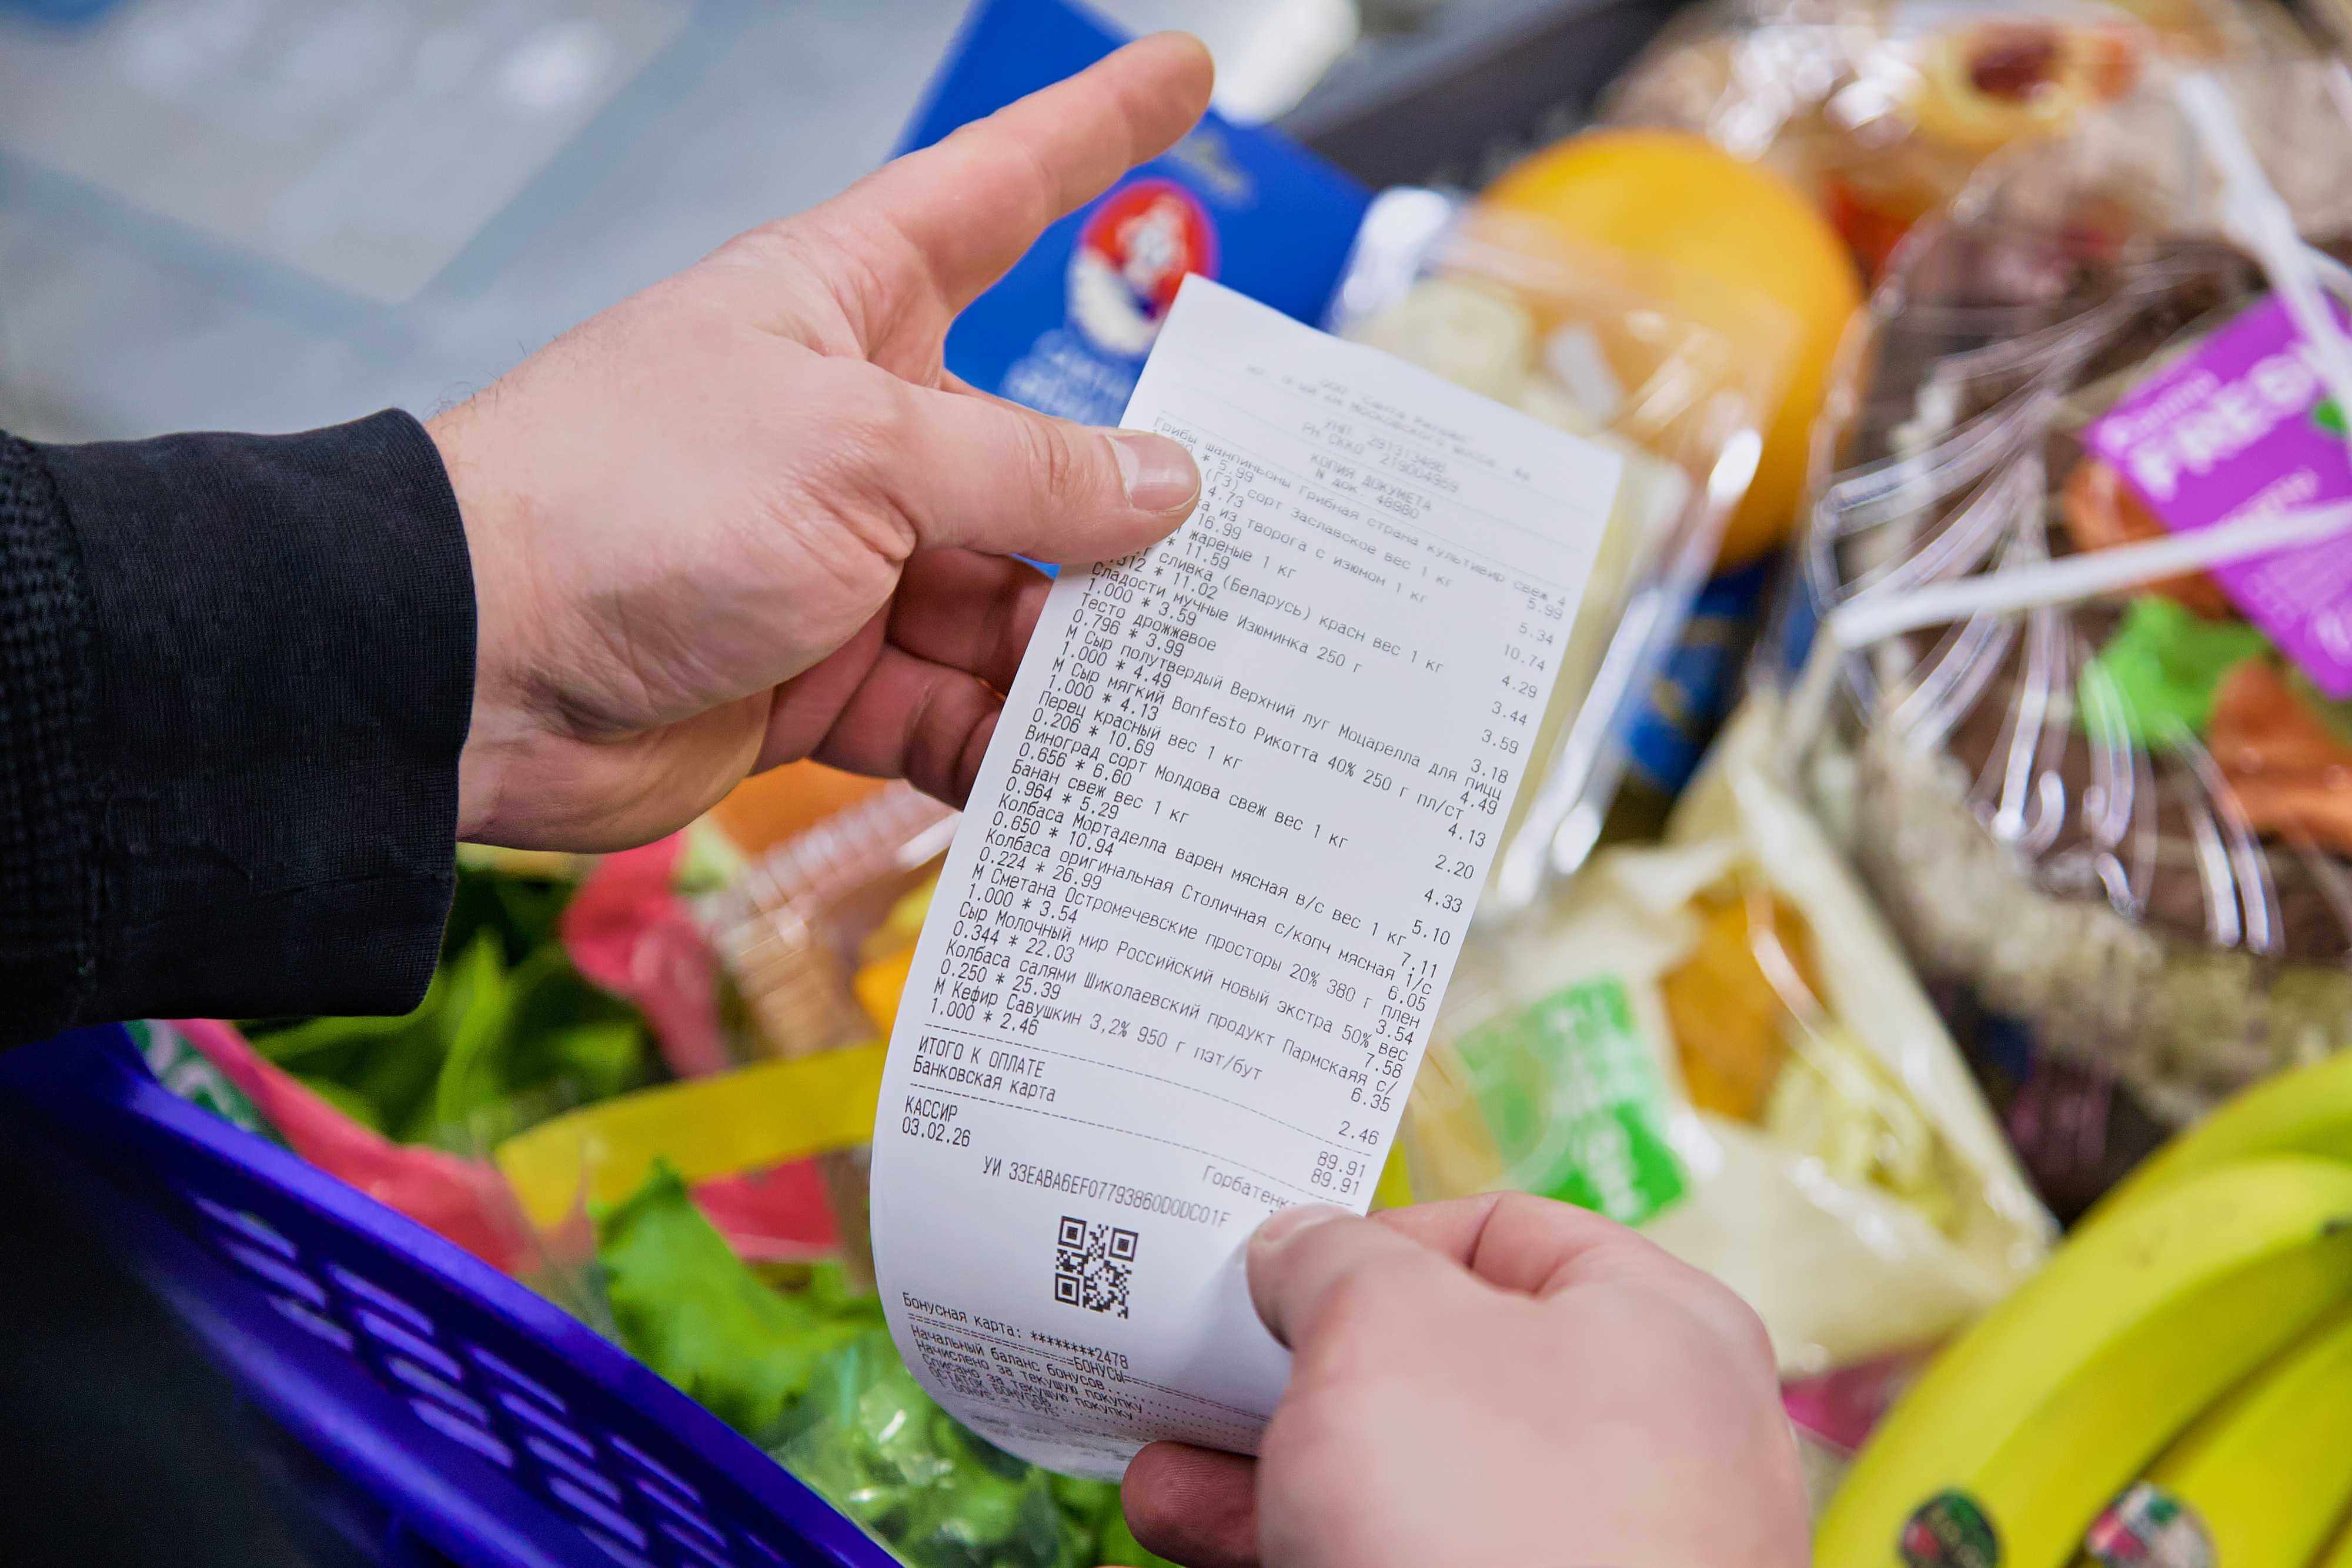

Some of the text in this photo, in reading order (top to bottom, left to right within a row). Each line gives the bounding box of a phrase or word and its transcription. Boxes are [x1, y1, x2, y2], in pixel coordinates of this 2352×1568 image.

[1154, 417, 1197, 444] Грибы
[1204, 442, 1291, 488] шампиньоны
[1298, 484, 1359, 520] Грибная
[1367, 517, 1419, 546] страна
[1514, 581, 1548, 601] свеж
[1218, 459, 1563, 620] 5.99 5.99
[1247, 489, 1282, 510] сорт
[1290, 507, 1377, 554] Заславское
[1310, 453, 1355, 479] КОПИЯ
[1081, 591, 1216, 651] Тесто дрожжевое
[1091, 561, 1345, 667] Сладости мучные Изюминка 250
[1158, 552, 1213, 582] сливка
[1222, 574, 1311, 620] (Беларусь)
[1318, 616, 1365, 641] красн
[1372, 637, 1401, 656] вес
[1185, 541, 1538, 698] 11.59 4.29
[1188, 529, 1252, 561] жареные
[1198, 512, 1545, 671] 16.99 10.74
[1207, 485, 1244, 508] 4.73
[1519, 621, 1553, 645] 5.34
[1247, 518, 1385, 586] творога изюмом
[1038, 690, 1197, 753] Перец красный вес
[1072, 608, 1508, 784] 0.796 3.99 3.18
[1084, 630, 1502, 801] Сыр полутвердый Верхний луг Моцарелла для пицц
[1088, 577, 1519, 754] 1.000 3.59 3.59
[1173, 571, 1527, 726] 11.02 3.44
[1011, 758, 1143, 808] Банан свеж вес
[1024, 723, 1303, 831] Виноград сорт Молдова свеж вес
[1032, 707, 1474, 879] 0.206 10.69 2.20
[1048, 674, 1486, 847] 1.000 4.13 4.13
[1061, 640, 1498, 815] 1.000 4.49 4.49
[1071, 662, 1464, 820] Сыр мягкий Bonfesto Рикотта 40% 250 пл/ст
[992, 810, 1437, 978] 0.650 10.94 7.11
[998, 792, 1361, 928] Колбаса Мортаделла варен мясная в/с вес
[1005, 775, 1450, 945] 0.964 5.29 5.10
[1018, 741, 1462, 912] 0.656 6.60 4.33
[968, 882, 1414, 1045] 1.000 3.54 3.54
[979, 846, 1426, 1011] 0.224 26.99 6.05
[984, 827, 1395, 981] Колбаса оригинальная Столичная с/копч мясная
[990, 867, 1420, 1029] Сметана Остромечевские просторы 20% 380 плен
[940, 958, 1391, 1112] 0.250 25.39 6.35
[945, 938, 1368, 1086] Колбаса салями Шиколаевский продукт Пармскаяя
[951, 981, 1262, 1079] Кефир Савушкин 3,2% 950 пэт/бут
[953, 920, 1403, 1078] 0.344 22.03 7.58
[959, 901, 1408, 1062] Сыр Молочный мир Российский новый экстра 50% вес
[901, 1115, 971, 1147] 03.02.26
[904, 1095, 958, 1122] КАССИР
[913, 1054, 1359, 1195] Банковская карта 89.91
[918, 1035, 1365, 1178] ИТОГО ОПЛАТЕ 89.91
[931, 997, 1379, 1145] 1.000 2.46 2.46
[982, 1155, 1002, 1176] УИ
[902, 1291, 1021, 1338] Бонусная карта:
[910, 1324, 1040, 1372] Начальный баланс
